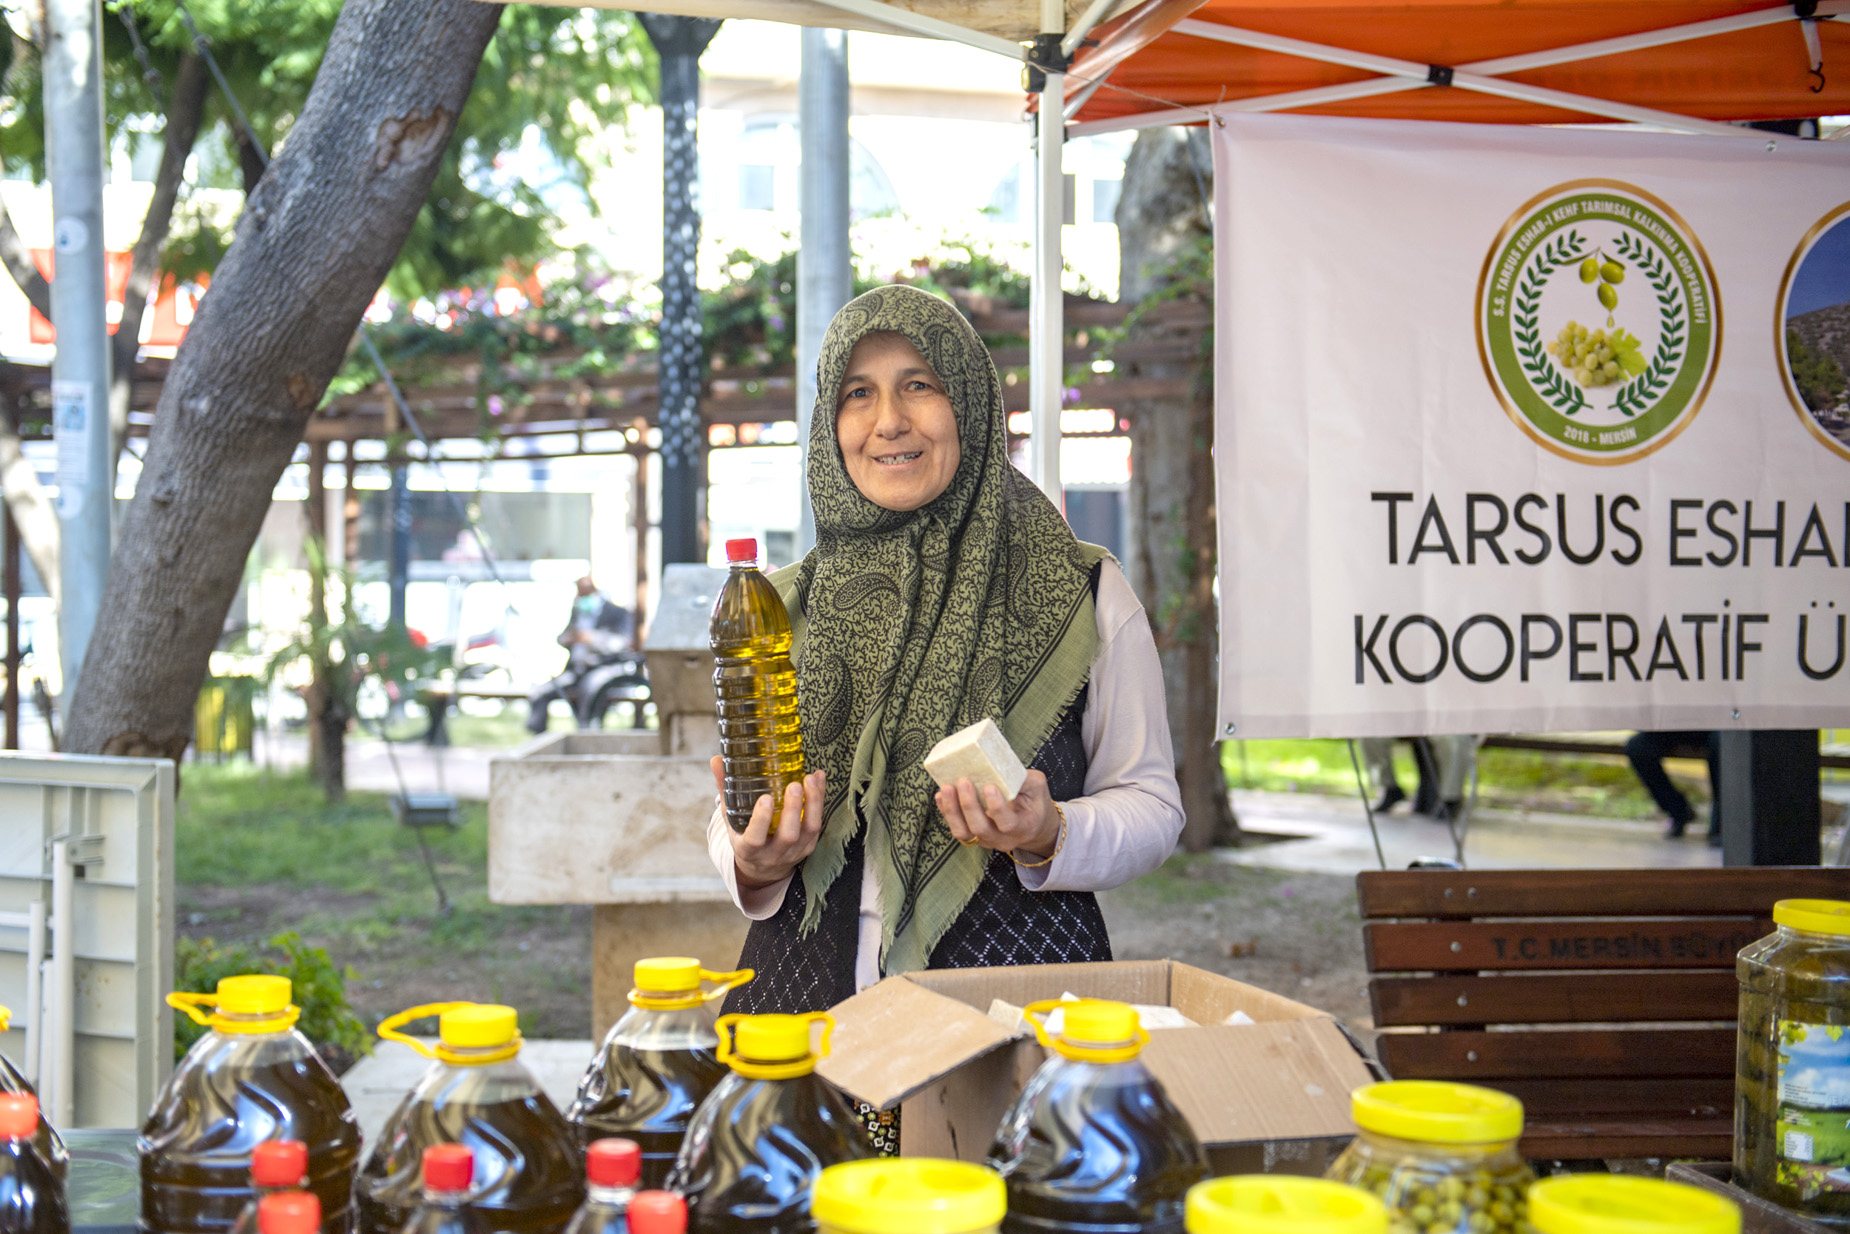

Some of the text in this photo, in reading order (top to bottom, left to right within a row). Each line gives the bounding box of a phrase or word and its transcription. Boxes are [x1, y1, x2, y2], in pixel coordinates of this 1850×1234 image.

[1496, 248, 1522, 292] TARSUS
[1552, 202, 1579, 222] KEHF
[1580, 200, 1632, 219] TARIMSAL
[1633, 210, 1680, 254] KALKINMA
[1675, 250, 1709, 324] KOOPERATİFİ
[1599, 426, 1638, 446] MERSİN
[1371, 491, 1850, 567] TARSUS ESHA
[1354, 599, 1770, 684] KOOPERATİF
